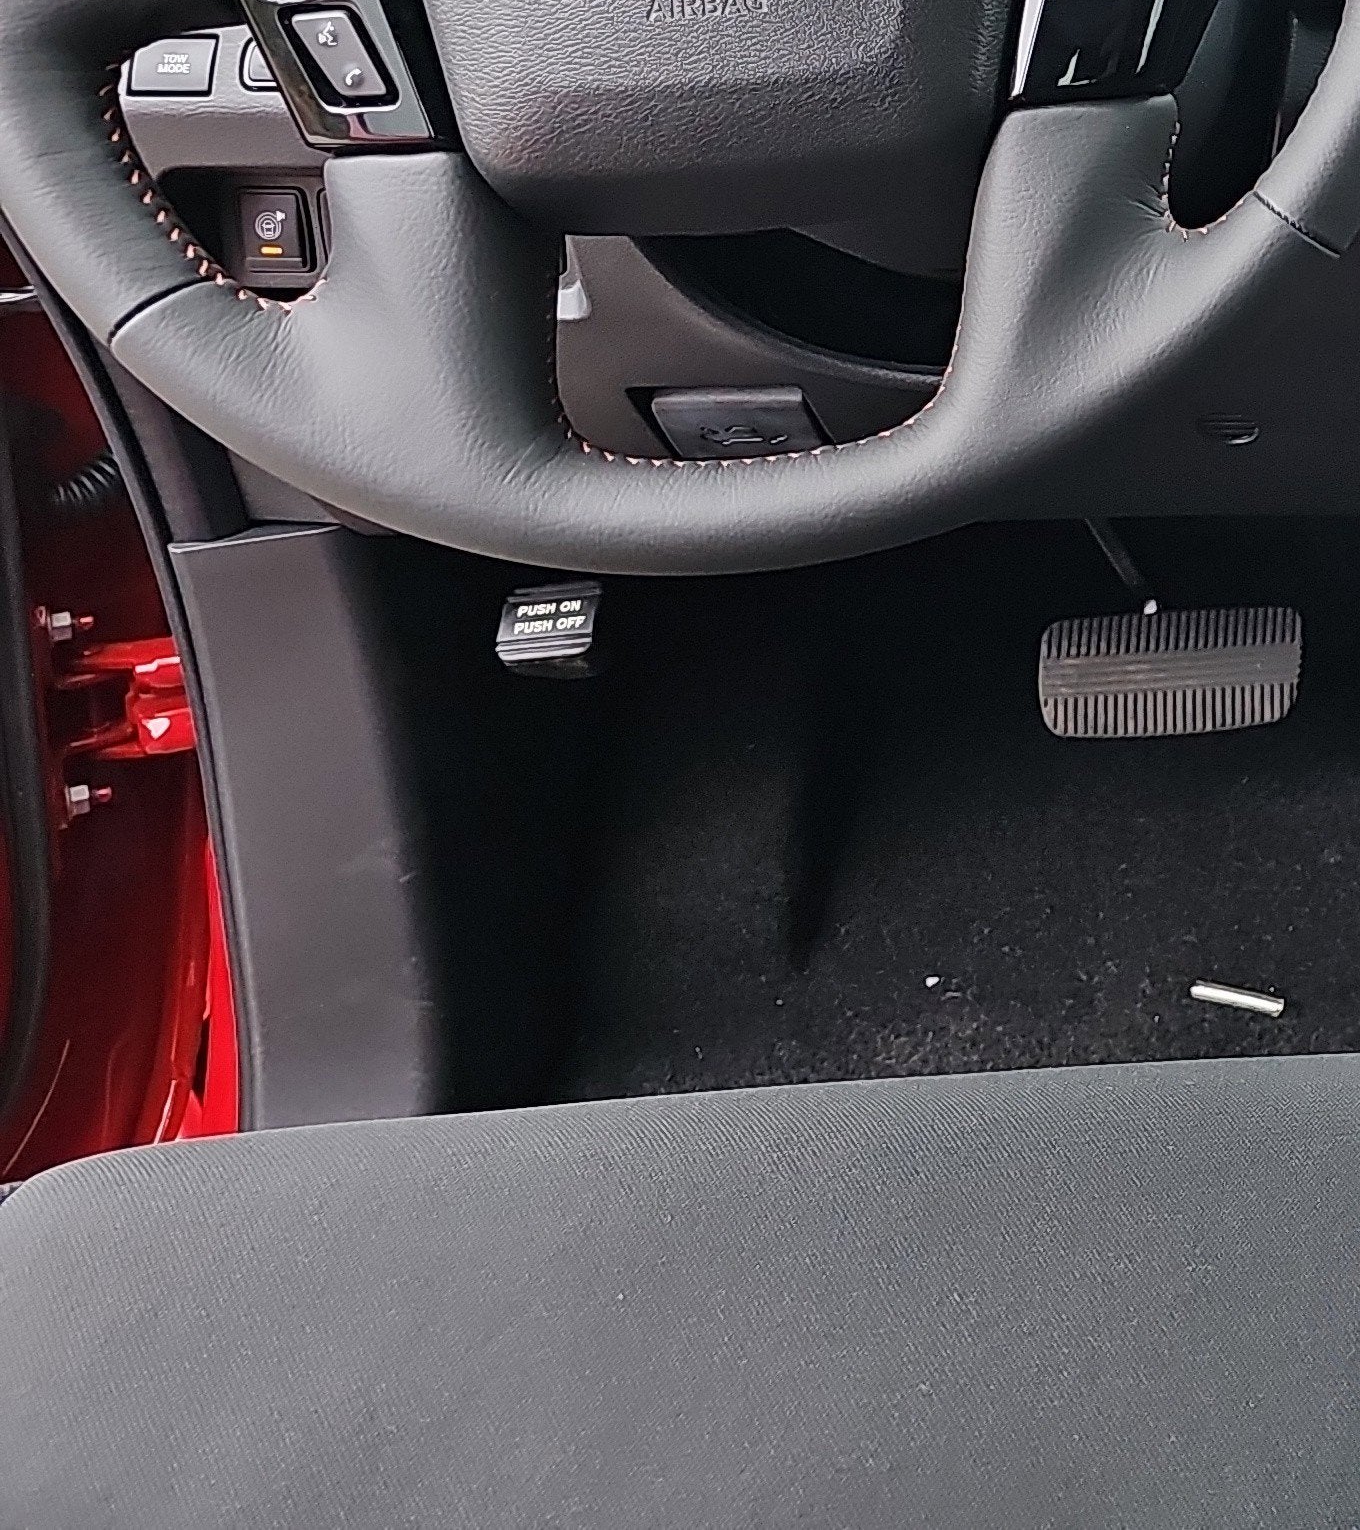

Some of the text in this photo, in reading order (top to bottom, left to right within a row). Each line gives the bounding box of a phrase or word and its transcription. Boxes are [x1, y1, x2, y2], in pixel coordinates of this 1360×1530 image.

[162, 54, 189, 64] TOW
[157, 63, 191, 74] MODE
[517, 599, 581, 618] PUSH ON
[514, 615, 586, 635] PUSH OFF
